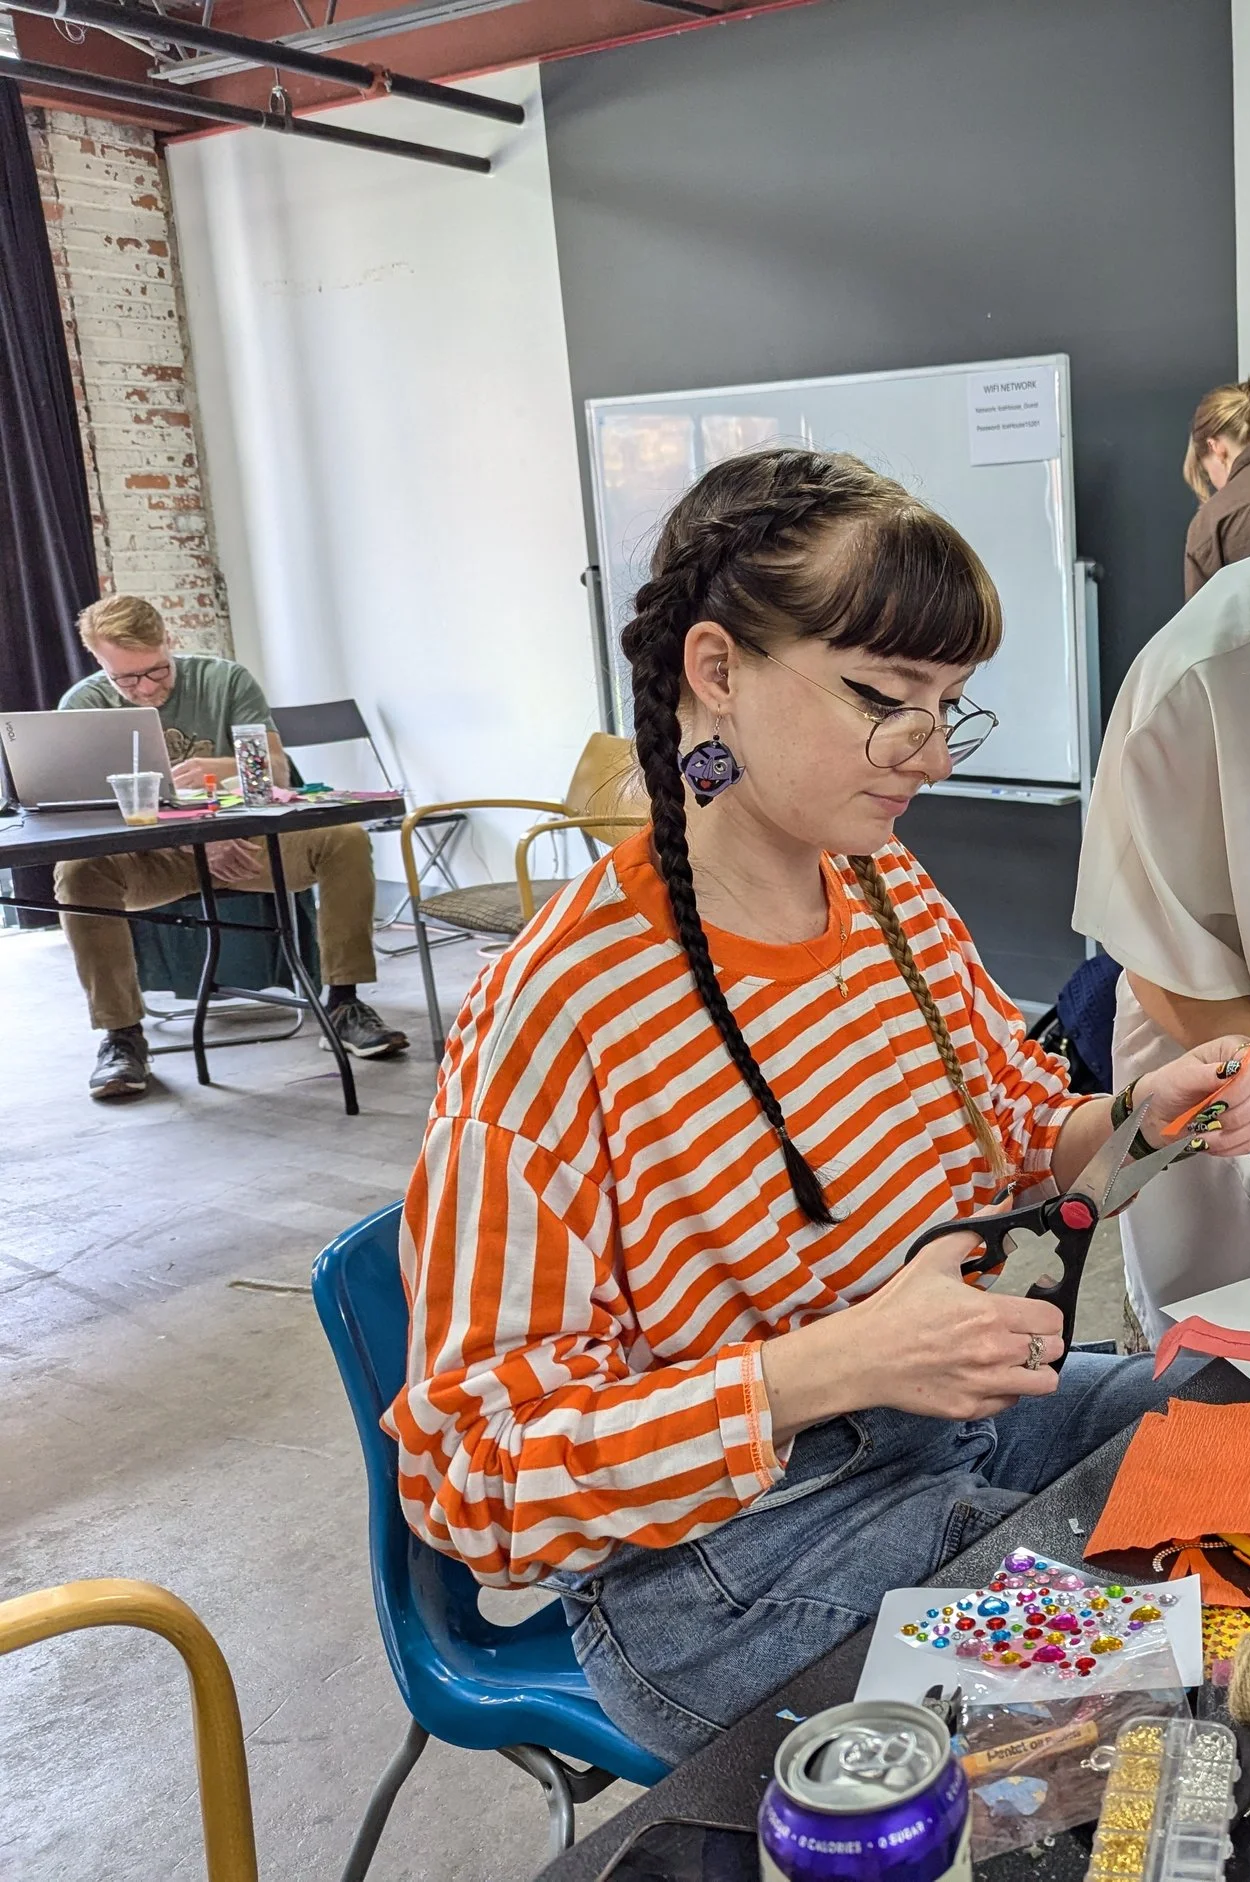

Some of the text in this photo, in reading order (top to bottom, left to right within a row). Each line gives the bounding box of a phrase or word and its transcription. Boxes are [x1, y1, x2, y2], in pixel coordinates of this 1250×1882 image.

[983, 380, 1037, 394] WIFI NETWORK
[986, 1742, 1029, 1762] Pentel
[807, 1837, 863, 1855] CALORIES
[888, 1820, 926, 1847] SUGAR
